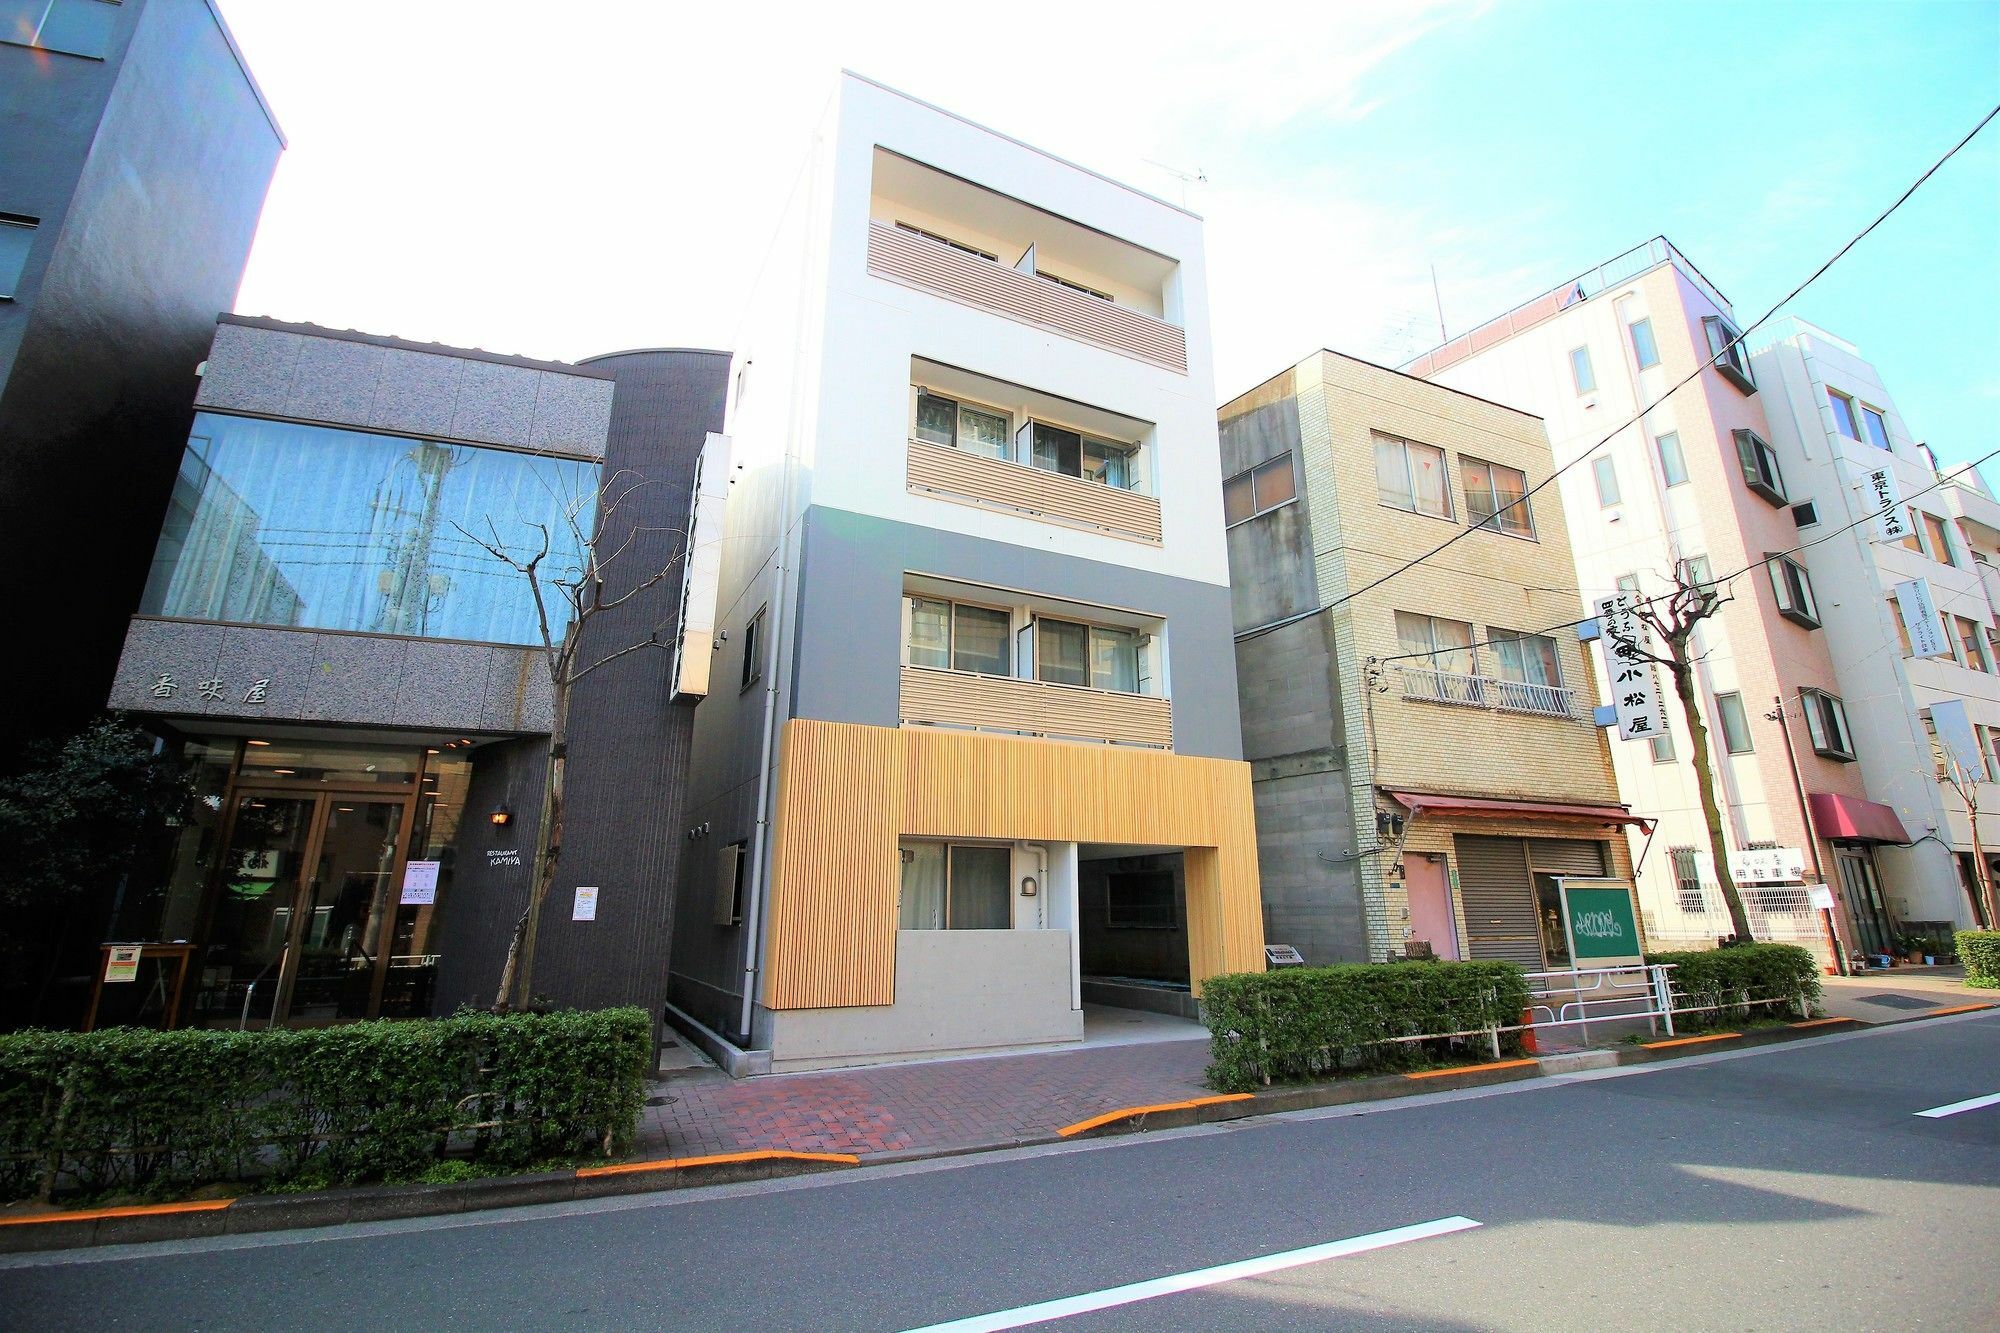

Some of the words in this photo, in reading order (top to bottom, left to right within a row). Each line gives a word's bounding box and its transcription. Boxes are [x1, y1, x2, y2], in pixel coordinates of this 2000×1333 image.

[1616, 596, 1634, 632] とうふ
[151, 673, 270, 704] 香味屋
[1616, 669, 1652, 734] 小松屋
[490, 856, 521, 867] KAMIYA
